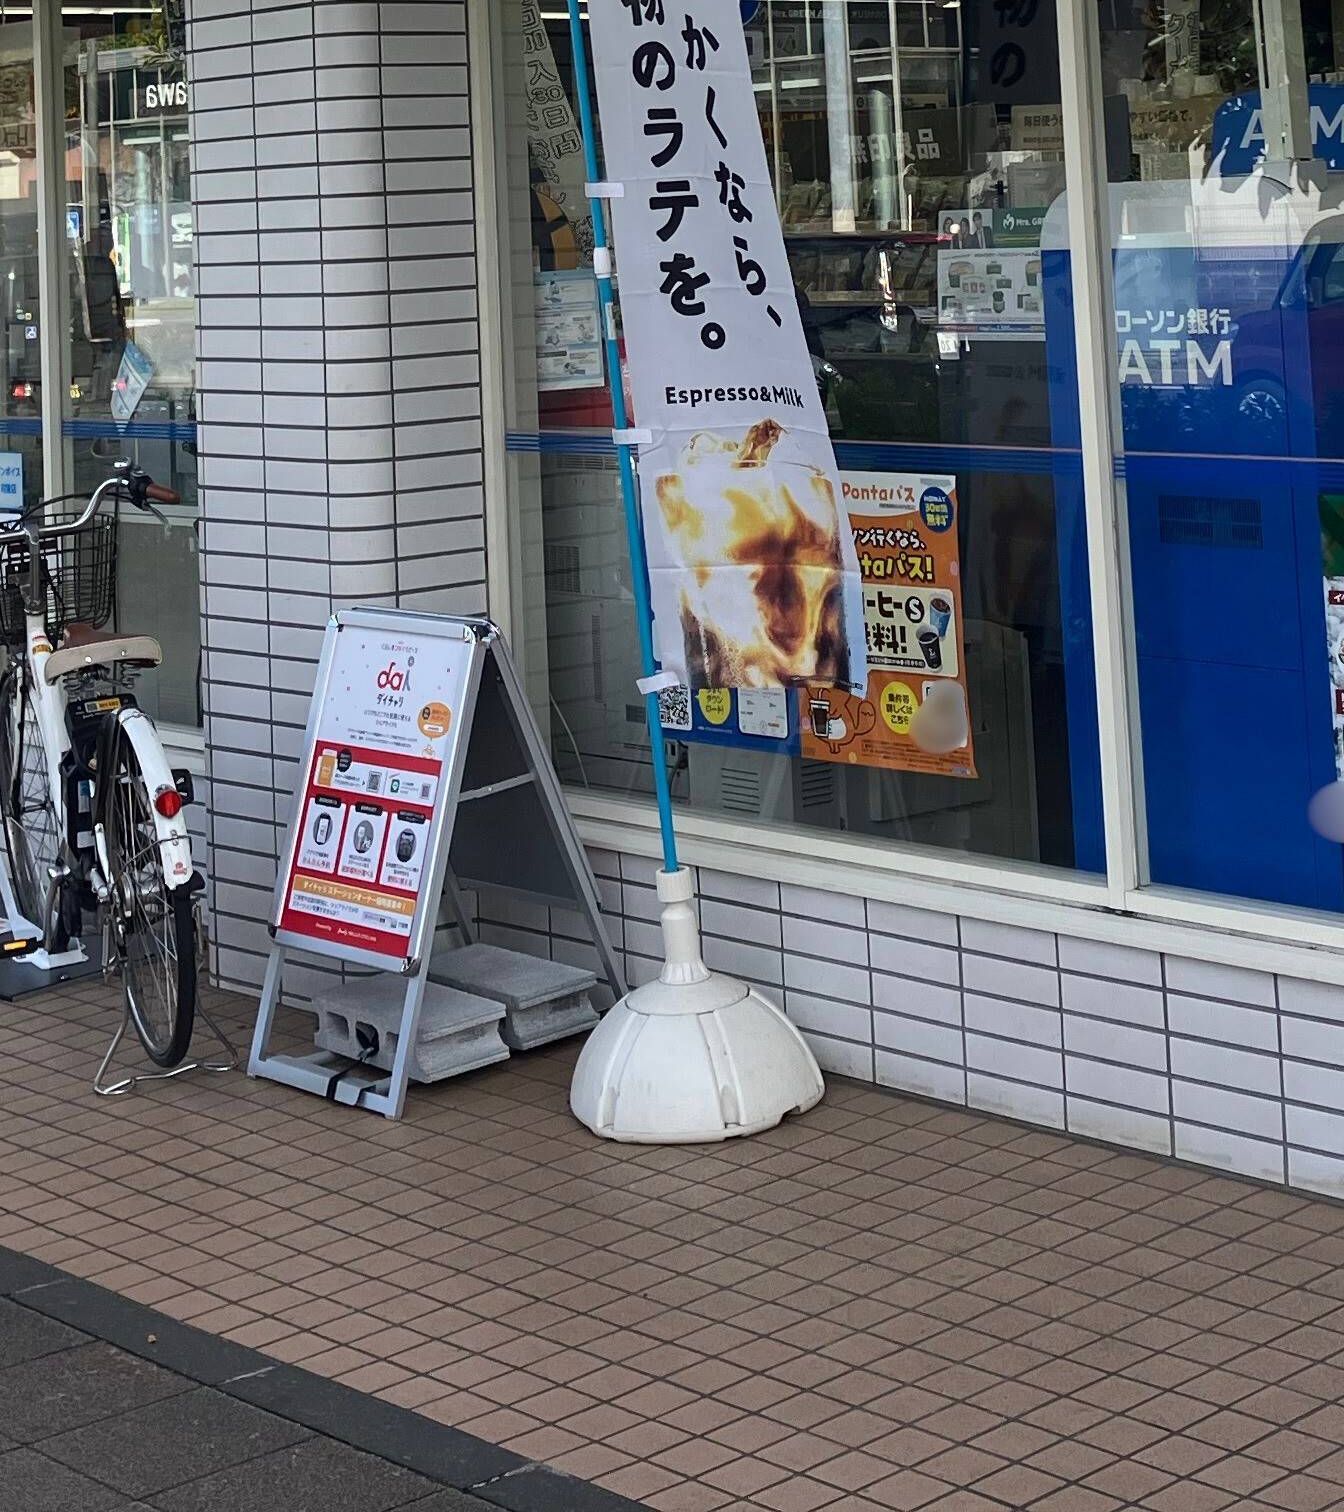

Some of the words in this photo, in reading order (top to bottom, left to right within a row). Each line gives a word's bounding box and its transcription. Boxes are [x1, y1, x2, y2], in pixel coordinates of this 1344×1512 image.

[1115, 307, 1233, 336] ローソン銀行
[1118, 339, 1234, 387] ATM
[665, 386, 804, 408] Espresso&Milk
[376, 693, 404, 707] ダイチャリ
